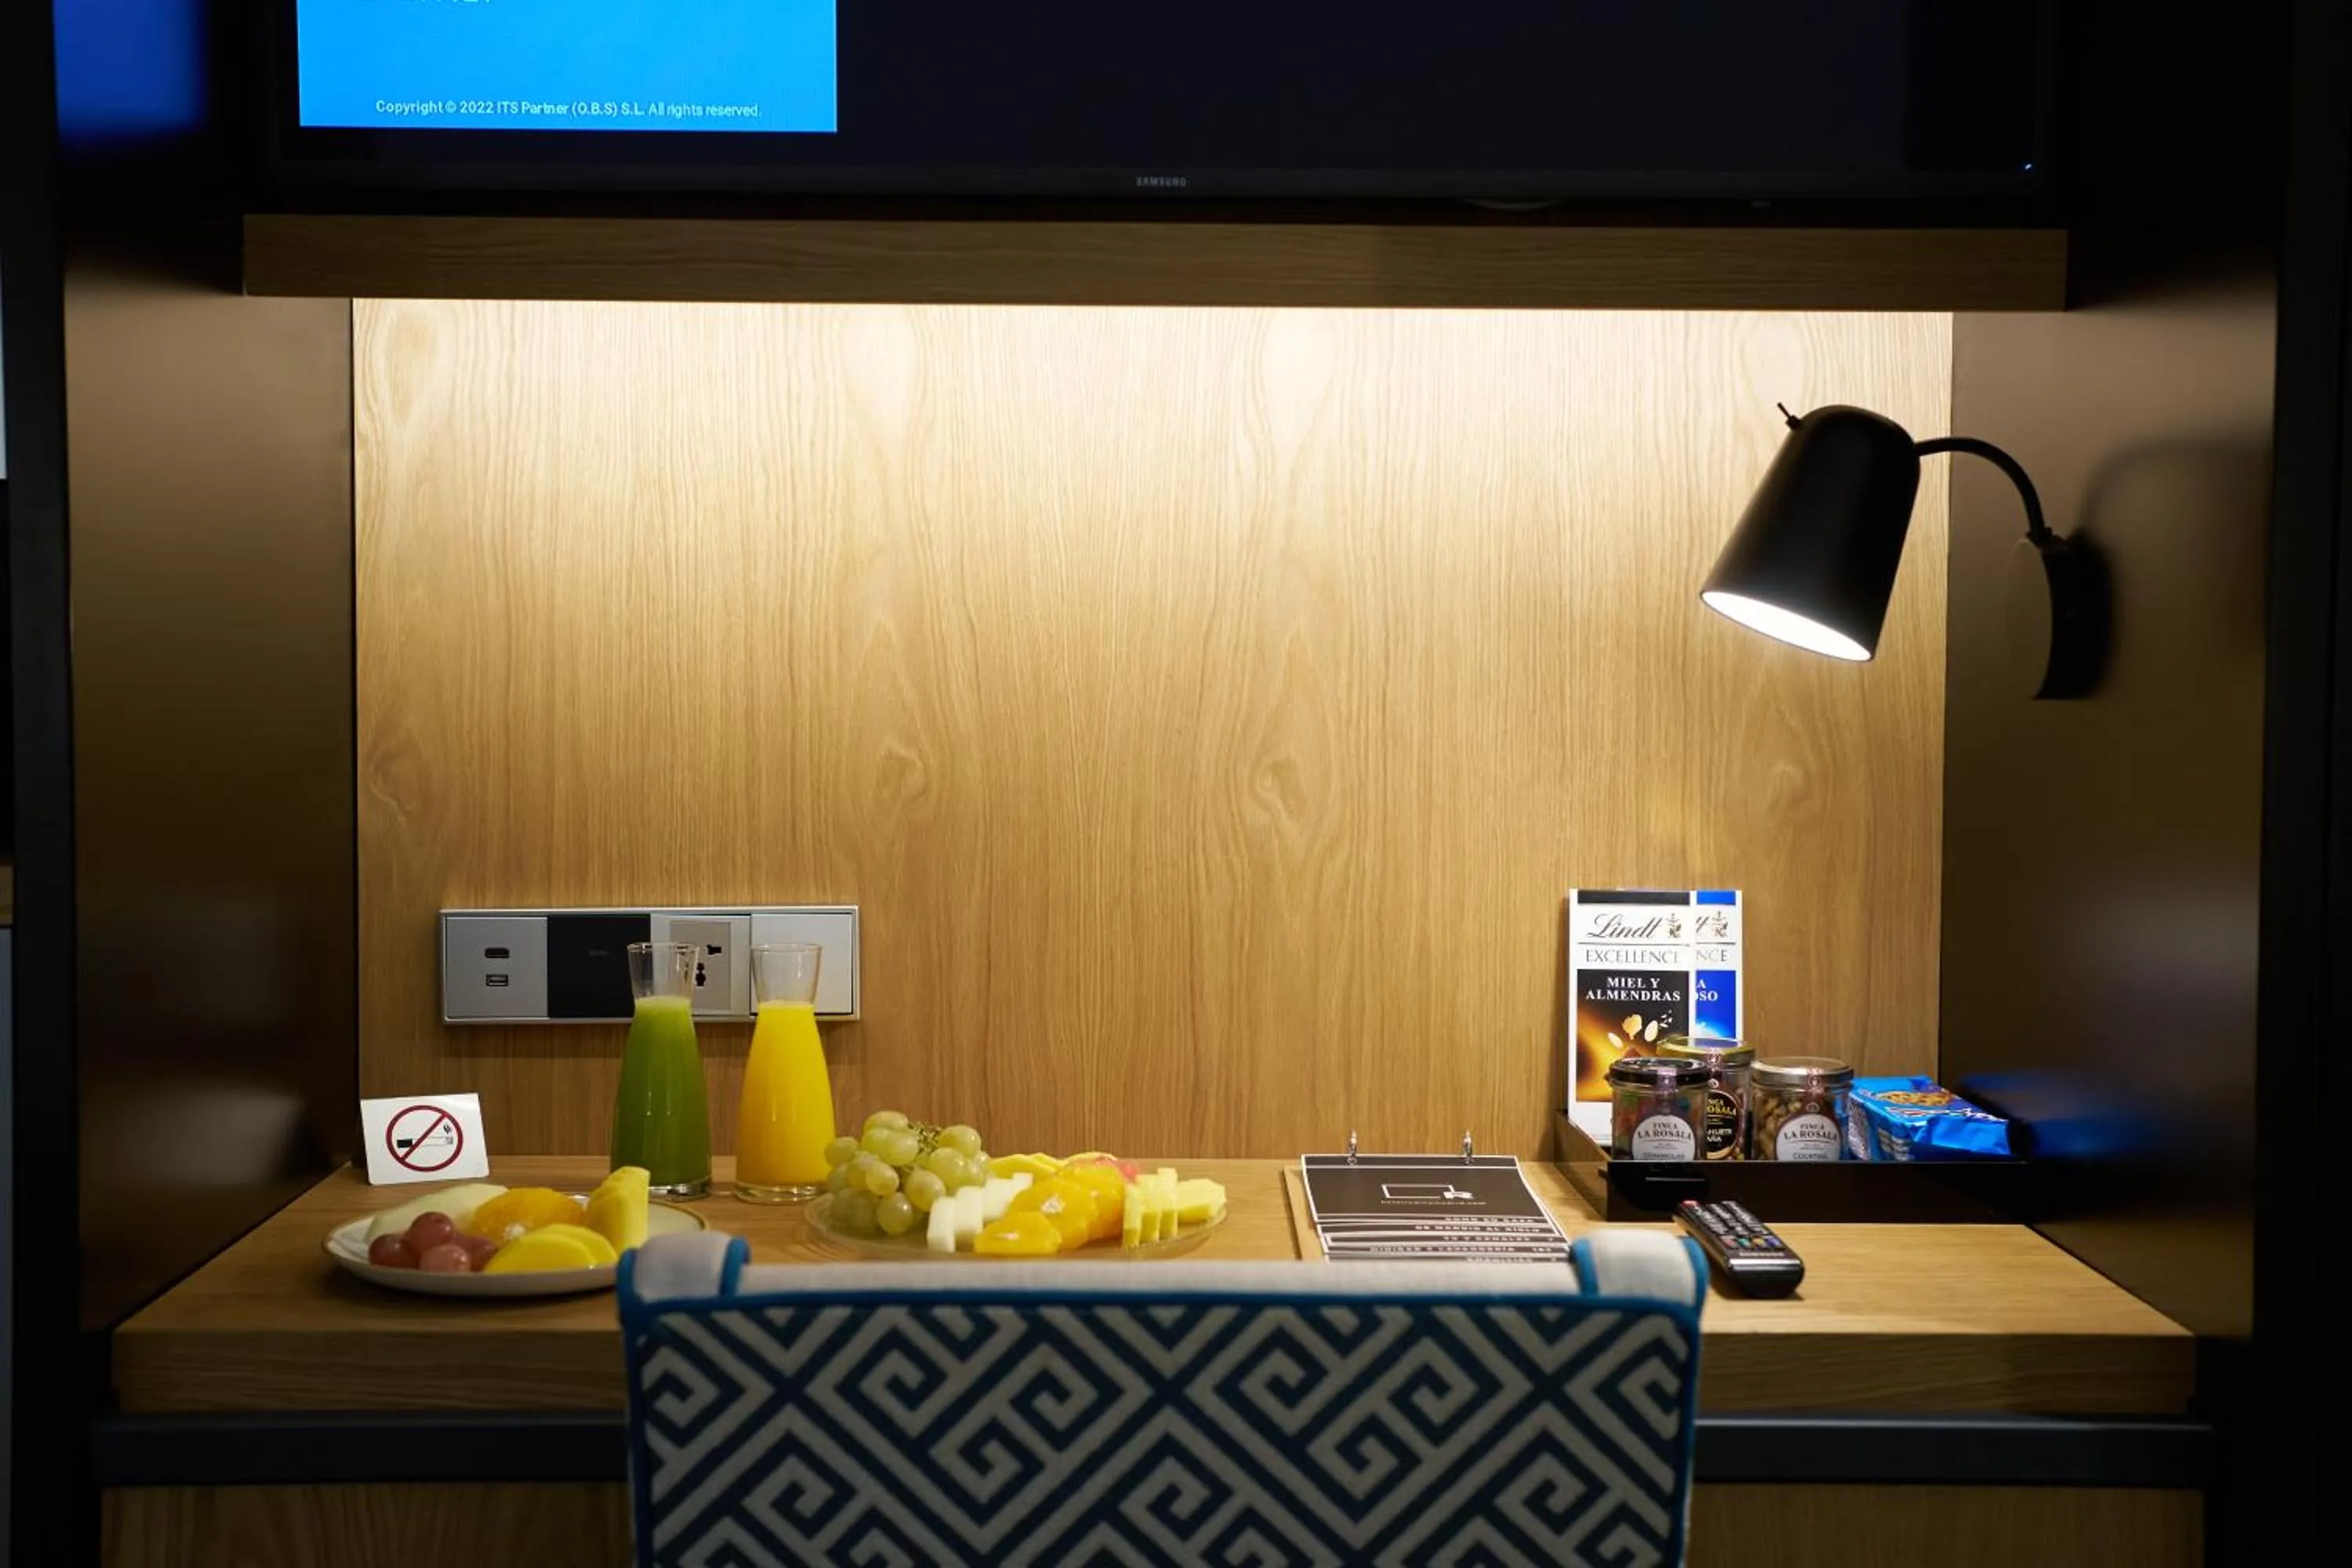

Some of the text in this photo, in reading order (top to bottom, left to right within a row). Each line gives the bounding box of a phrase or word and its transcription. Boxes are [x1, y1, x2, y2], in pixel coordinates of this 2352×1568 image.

[376, 100, 444, 115] Copyright
[460, 100, 494, 114] 2022
[497, 100, 519, 114] ITS
[521, 101, 569, 114] Partner
[572, 101, 618, 117] (O.B.S)
[621, 102, 645, 115] S.L.
[648, 102, 666, 116] All
[667, 102, 703, 118] rights
[706, 103, 762, 117] reserved.
[1587, 913, 1663, 939] Lindt
[1585, 949, 1679, 964] EXCELLENCE
[1606, 977, 1661, 989] MIEL Y
[1585, 989, 1682, 1002] ALMENDRAS
[1637, 1130, 1651, 1139] LA
[1784, 1131, 1798, 1141] LA
